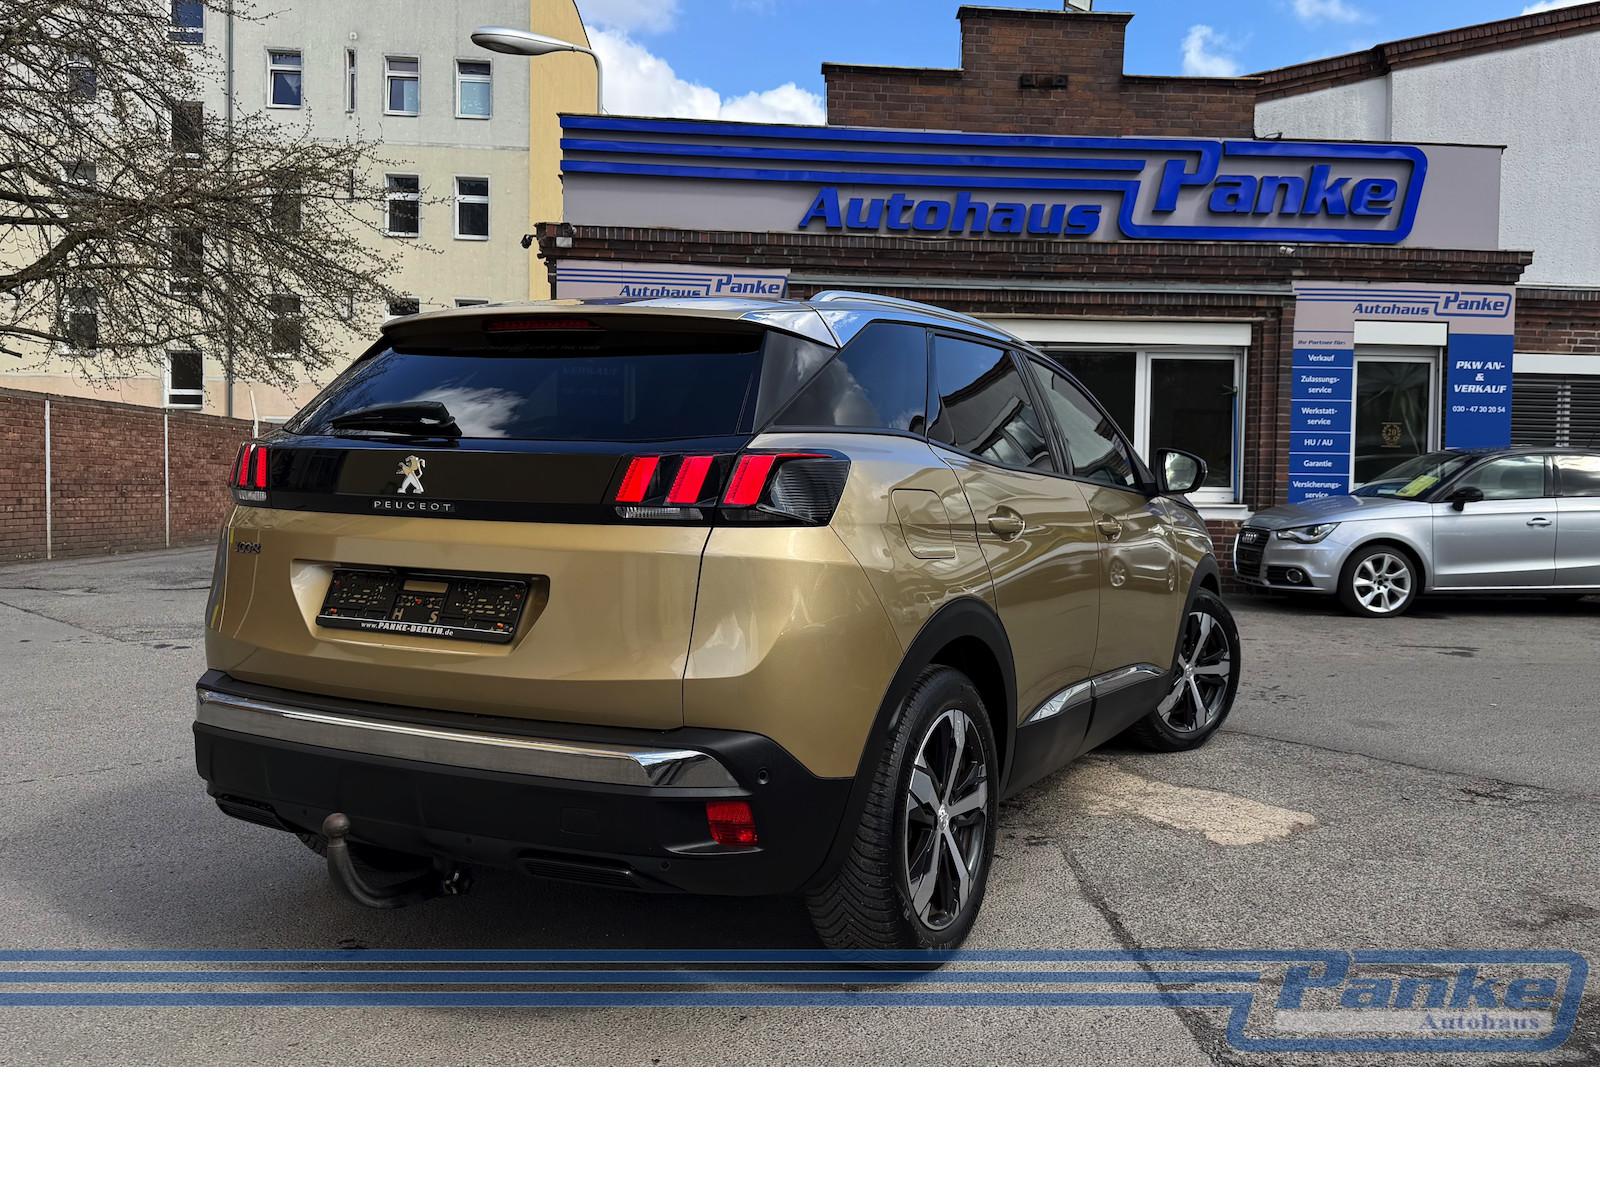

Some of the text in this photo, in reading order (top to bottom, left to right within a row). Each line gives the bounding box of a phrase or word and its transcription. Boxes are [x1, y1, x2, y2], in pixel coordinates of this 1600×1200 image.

[799, 141, 1398, 238] Autohaus Panke
[619, 274, 780, 297] Autohaus Panke
[1352, 292, 1505, 316] Autohaus Panke
[1307, 354, 1335, 362] Verkauf
[1455, 360, 1506, 370] PKW AN-
[1300, 375, 1340, 384] Zulassungs-
[1475, 372, 1485, 382] &
[1308, 386, 1332, 394] service
[1453, 384, 1507, 394] VERKAUF
[1301, 407, 1338, 415] Werkstatt-
[1452, 405, 1465, 413] 030
[1470, 405, 1478, 413] 47
[1307, 417, 1331, 425] service
[1304, 438, 1316, 446] HU
[1321, 438, 1333, 447] AU
[1303, 459, 1333, 468] Garantie
[1292, 480, 1342, 489] Versicherungs-
[1304, 491, 1329, 499] service
[373, 500, 453, 512] PEUGEOT
